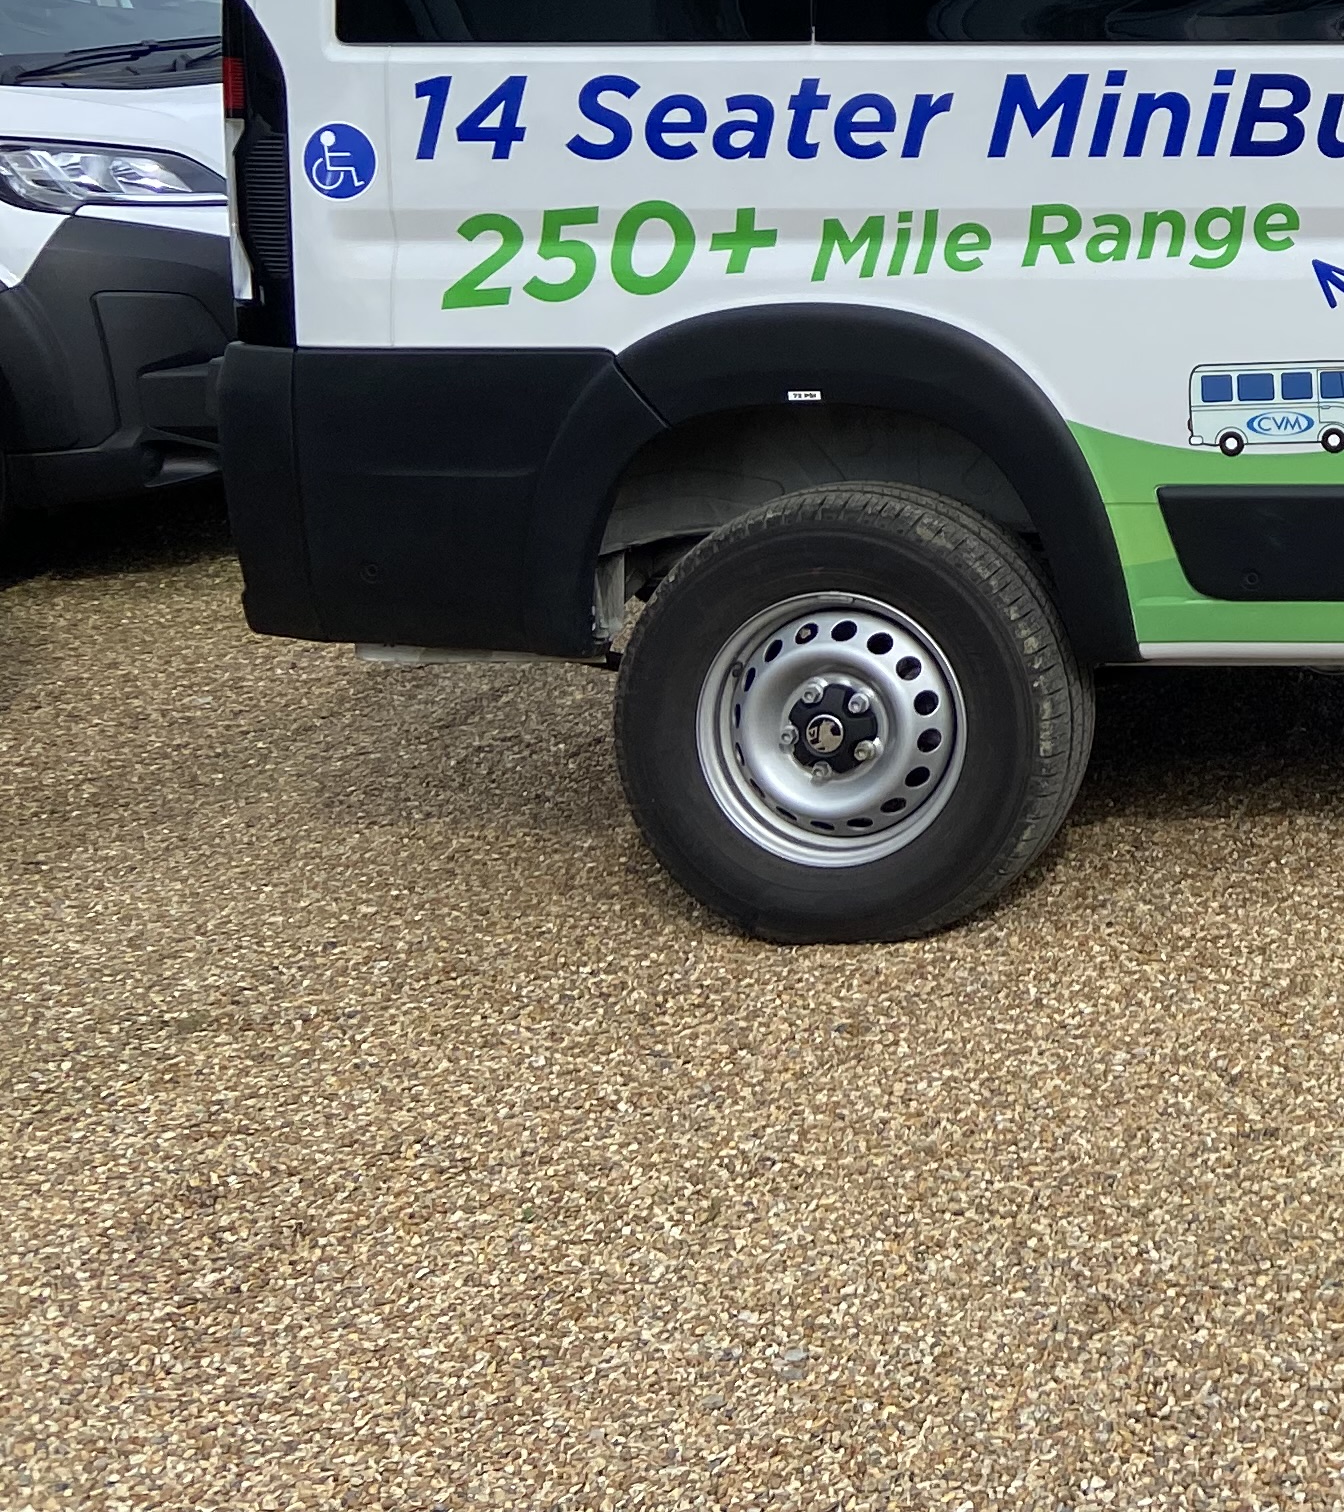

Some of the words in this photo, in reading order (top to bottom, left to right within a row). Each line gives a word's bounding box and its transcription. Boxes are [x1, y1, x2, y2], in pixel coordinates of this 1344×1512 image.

[414, 74, 529, 161] 14
[565, 73, 954, 162] Seater
[440, 199, 777, 310] 250+
[811, 209, 993, 282] Mile
[1022, 202, 1301, 270] Range
[1257, 416, 1303, 432] CVM
